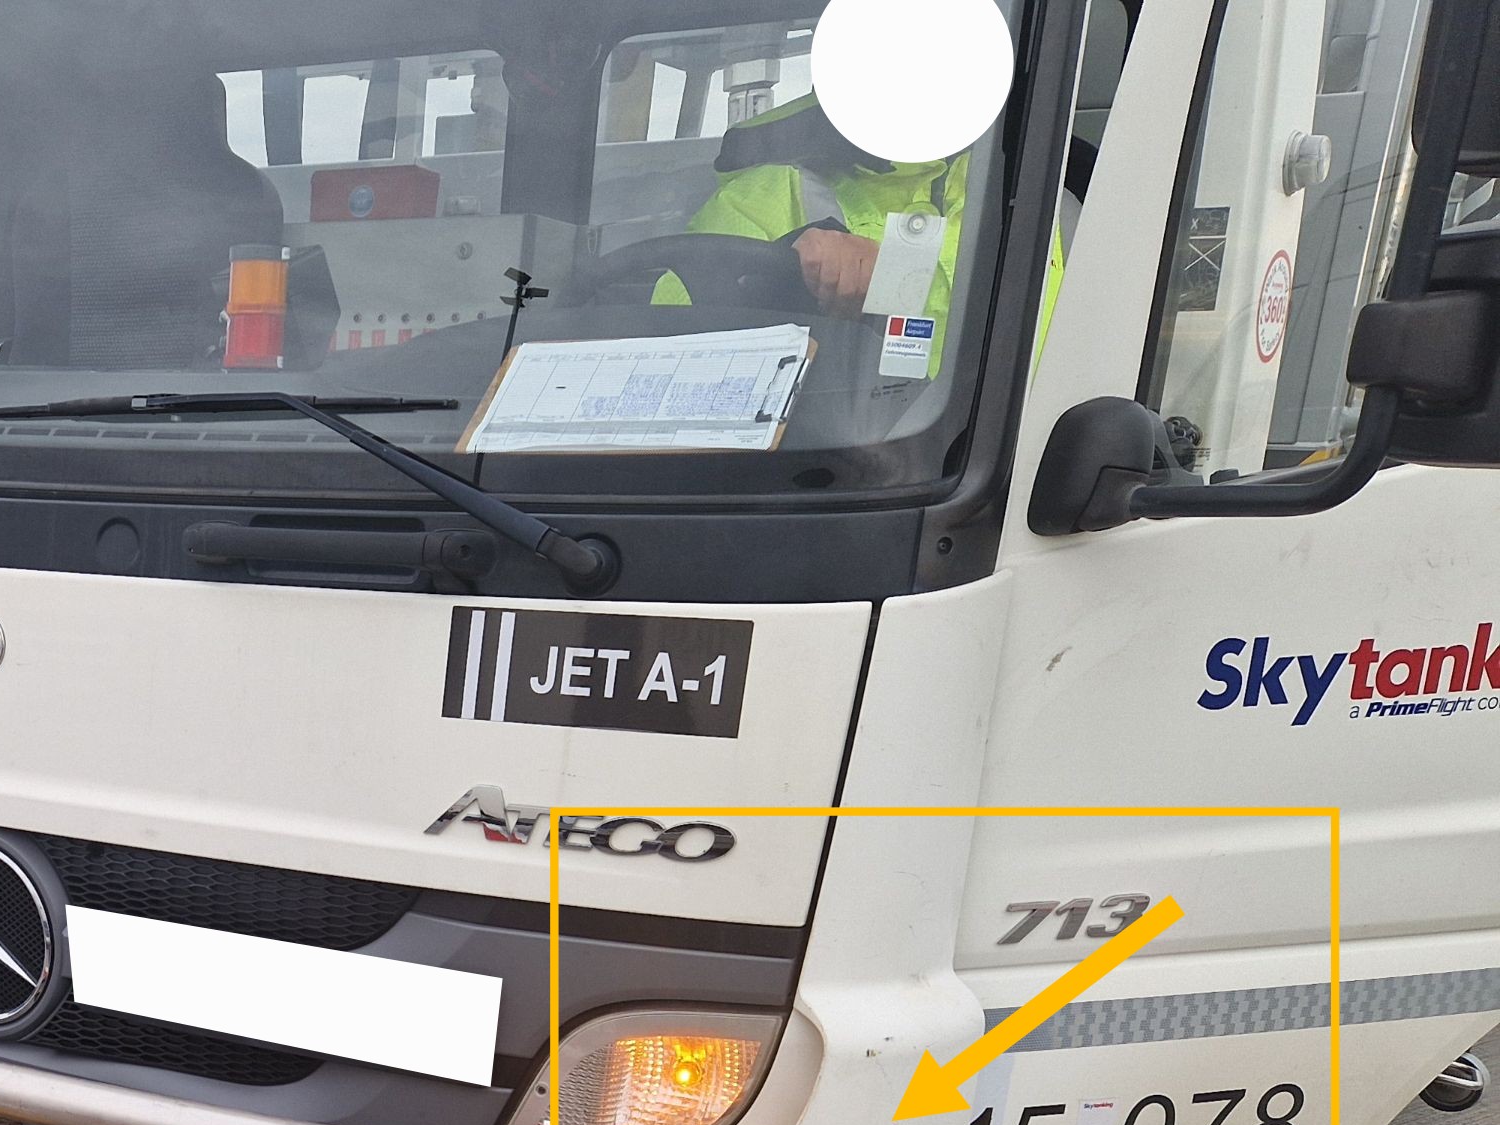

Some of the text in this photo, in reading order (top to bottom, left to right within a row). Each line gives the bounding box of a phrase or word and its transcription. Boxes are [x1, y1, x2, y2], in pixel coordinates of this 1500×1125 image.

[529, 645, 727, 705] JET A-1
[1196, 622, 1500, 727] Skytank
[1349, 705, 1360, 719] a
[1364, 696, 1476, 718] PrimeFlight
[997, 892, 1151, 945] 713
